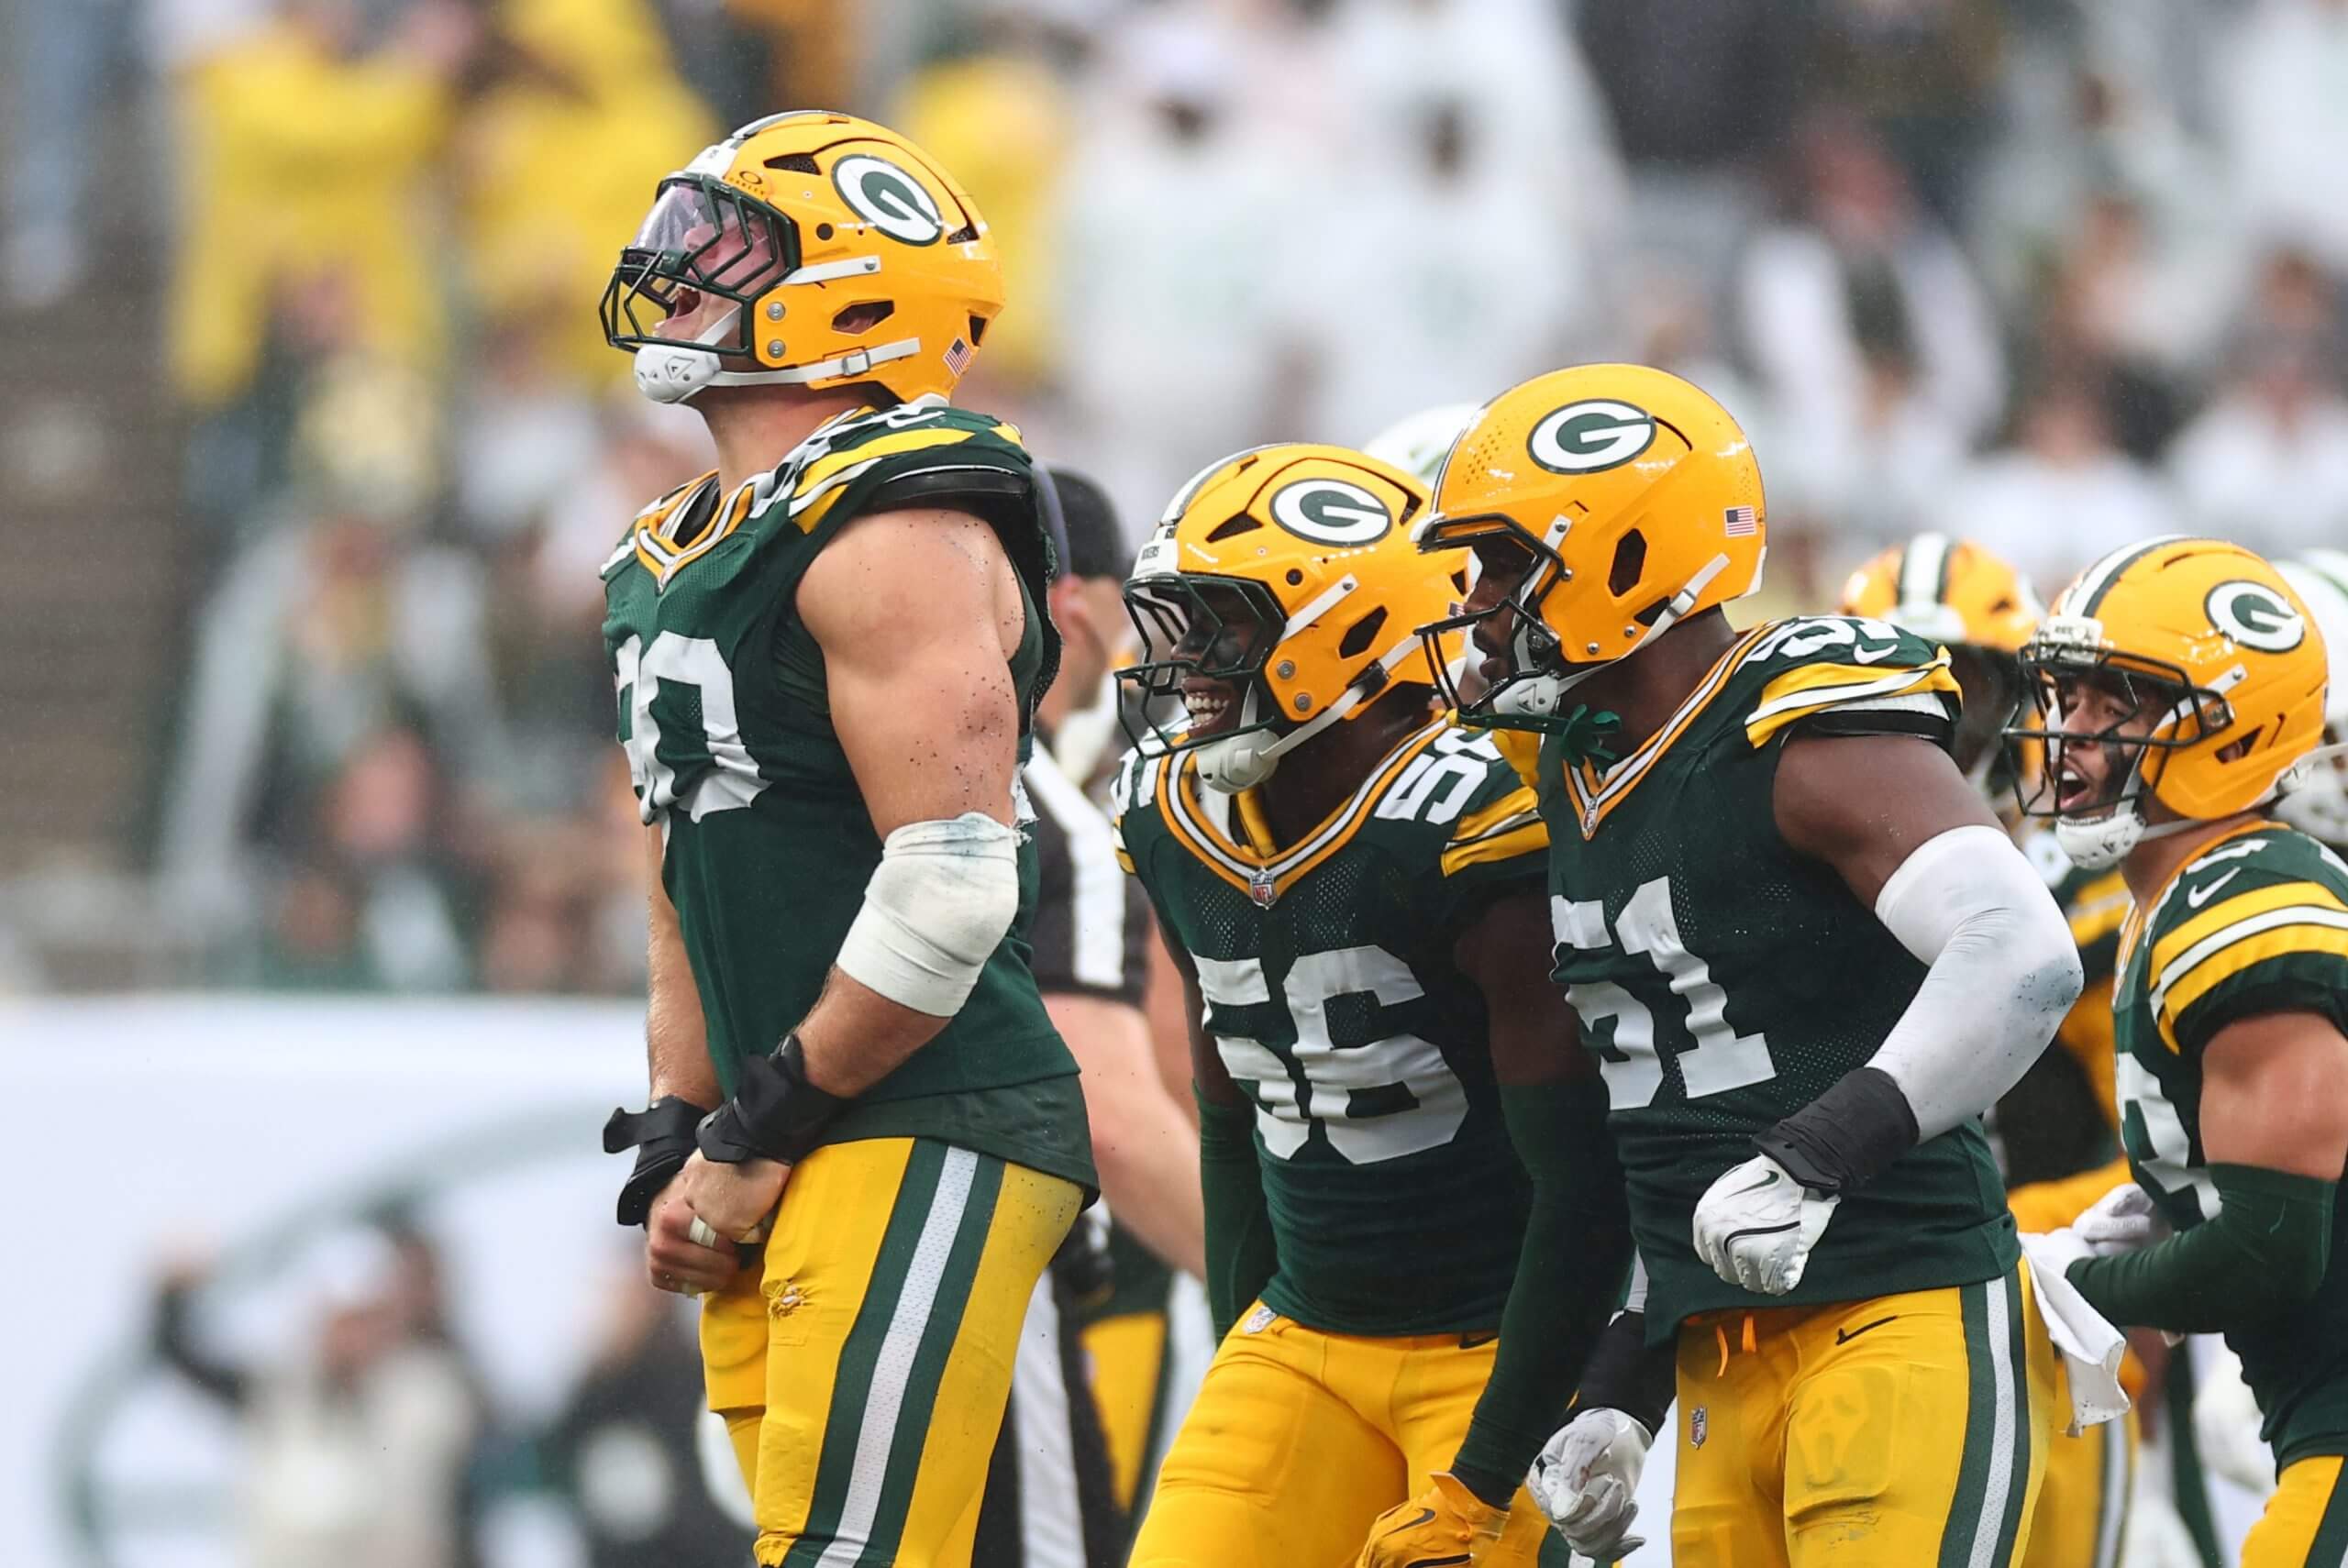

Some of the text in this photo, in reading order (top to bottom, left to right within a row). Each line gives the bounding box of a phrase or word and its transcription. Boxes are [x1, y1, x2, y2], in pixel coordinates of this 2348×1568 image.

[835, 157, 940, 242] G
[1530, 401, 1652, 469] G
[1274, 480, 1389, 543] G
[2207, 581, 2305, 650] G
[1550, 876, 1777, 1110] 51
[1188, 944, 1468, 1165] 56
